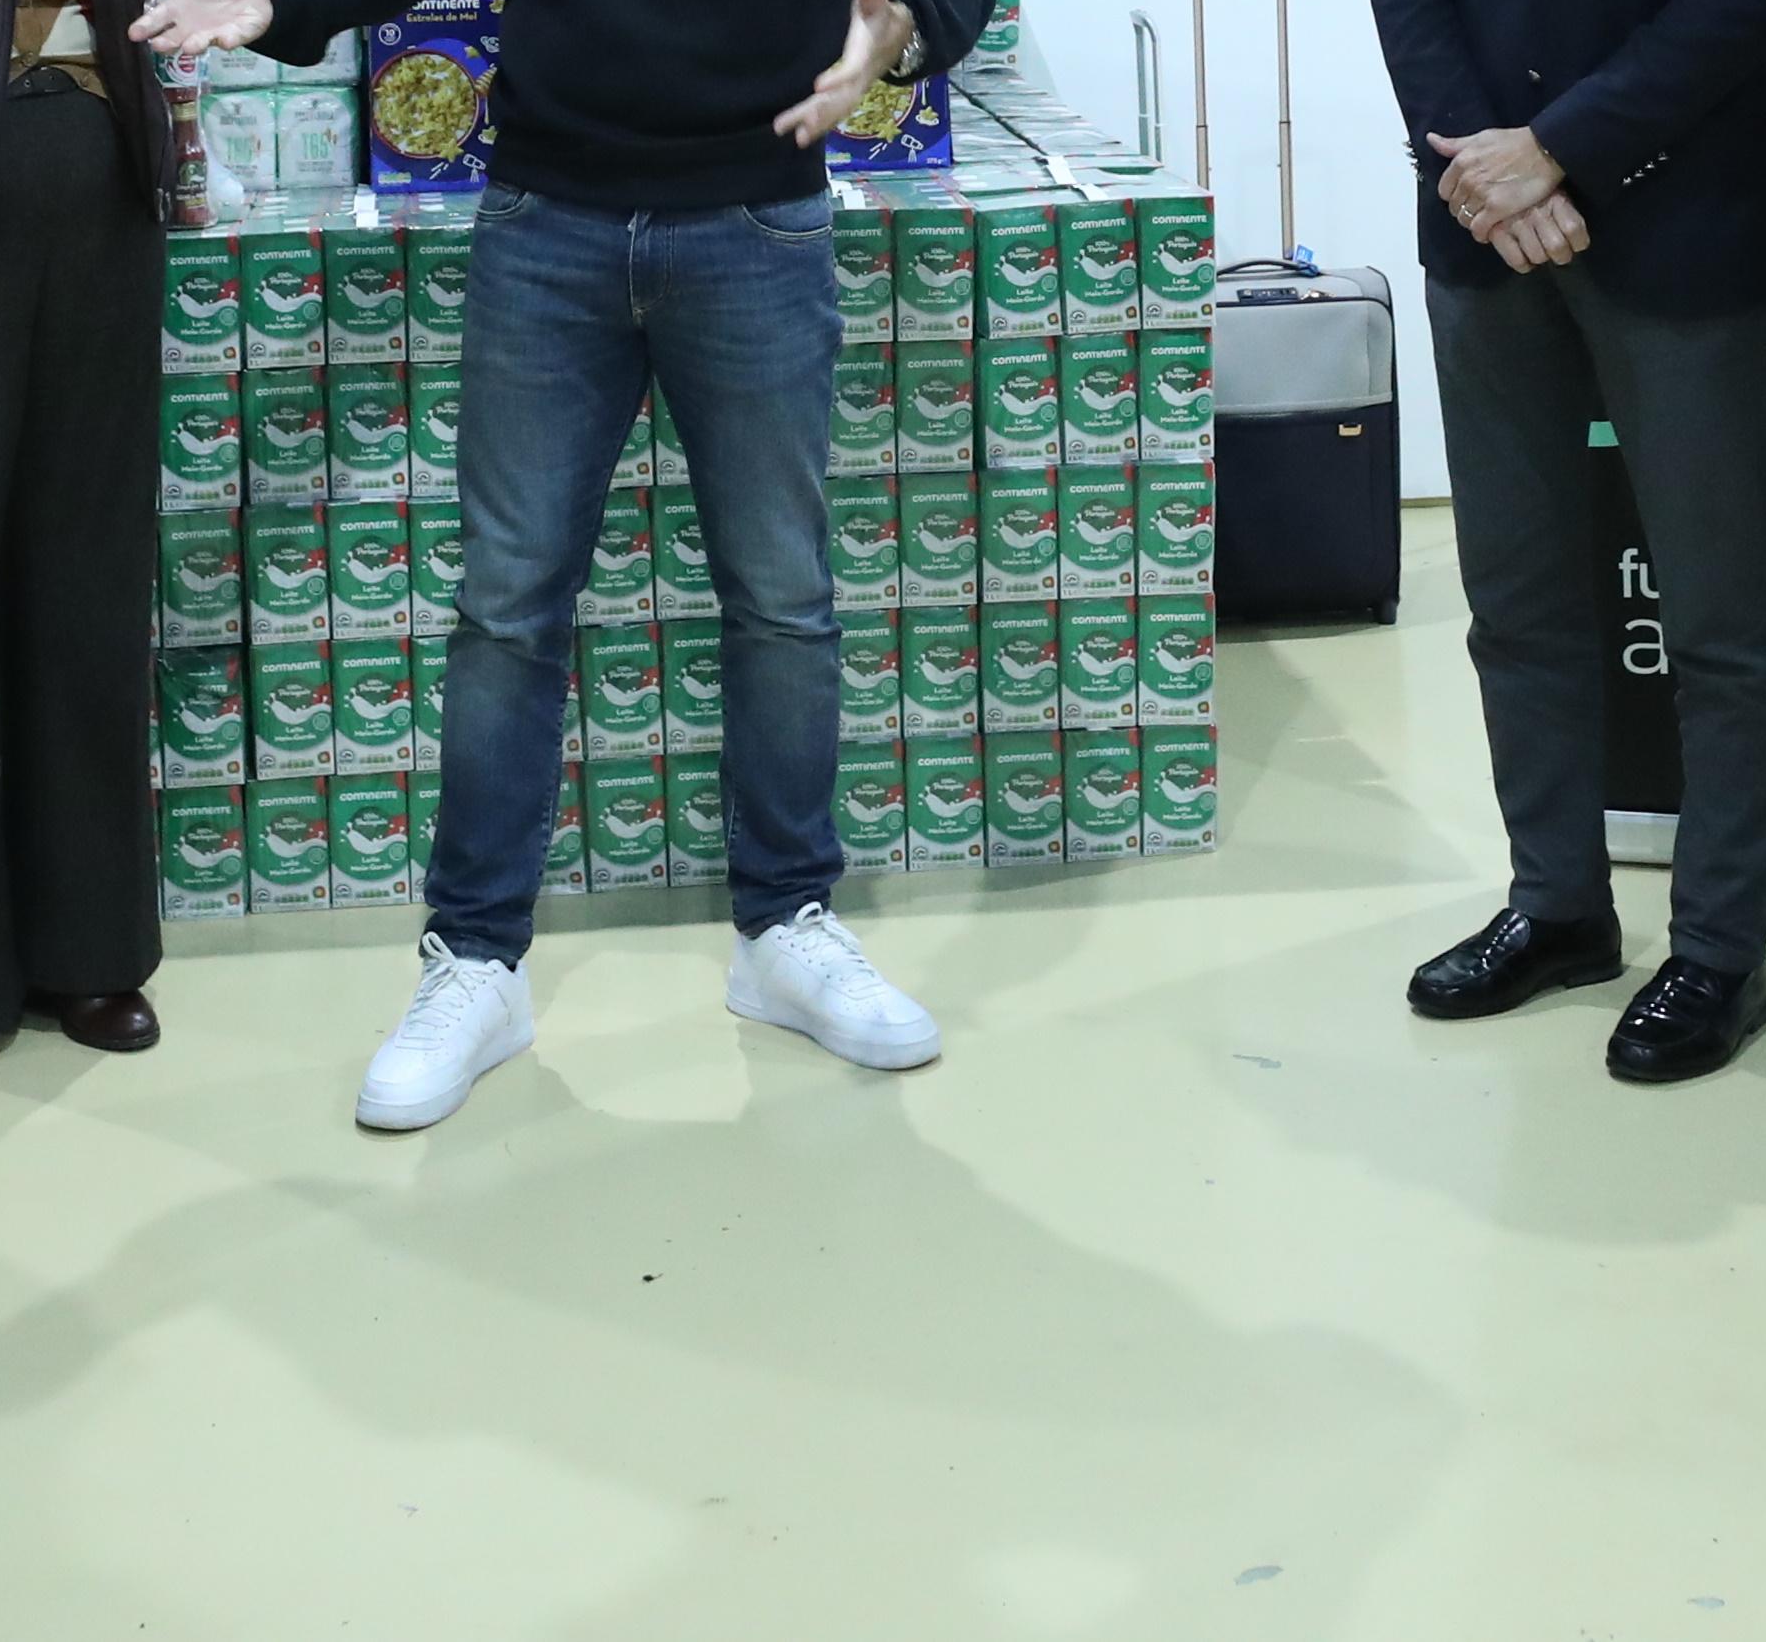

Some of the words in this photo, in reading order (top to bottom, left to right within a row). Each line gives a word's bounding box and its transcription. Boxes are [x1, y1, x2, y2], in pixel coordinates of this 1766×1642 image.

[406, 11, 444, 22] Estrelas
[446, 11, 458, 22] de
[459, 11, 477, 22] Mel
[1071, 217, 1126, 229] CONTINENTE
[1152, 215, 1207, 224] CONTINENTE
[908, 226, 965, 235] CONTINENTE
[991, 224, 1047, 236] CONTINENTE
[253, 249, 312, 261] CONTINENTE
[336, 245, 395, 256] CONTINENTE
[170, 254, 229, 266] CONTINENTE
[1072, 349, 1128, 360] CONTINENTE
[1151, 345, 1206, 355] CONTINENTE
[907, 359, 964, 369] CONTINENTE
[992, 354, 1048, 365] CONTINENTE
[255, 384, 314, 397] CONTINENTE
[339, 381, 397, 392] CONTINENTE
[170, 392, 229, 403] CONTINENTE
[1069, 483, 1125, 494] CONTINENTE
[1150, 481, 1206, 491] CONTINENTE
[912, 493, 969, 503] CONTINENTE
[992, 487, 1048, 498] CONTINENTE
[832, 496, 889, 506] CONTINENTE
[256, 525, 316, 537] CONTINENTE
[340, 520, 399, 531] CONTINENTE
[171, 529, 231, 540] CONTINENTE
[992, 618, 1049, 629] CONTINENTE
[1071, 614, 1128, 625] CONTINENTE
[1150, 613, 1206, 623] CONTINENTE
[913, 624, 970, 635] CONTINENTE
[593, 643, 650, 655] CONTINENTE
[262, 660, 321, 673] CONTINENTE
[343, 657, 401, 668] CONTINENTE
[1076, 747, 1130, 758] CONTINENTE
[1154, 742, 1210, 753] CONTINENTE
[917, 756, 974, 767] CONTINENTE
[996, 752, 1054, 764] CONTINENTE
[838, 761, 895, 772] CONTINENTE
[597, 775, 655, 788] CONTINENTE
[258, 795, 317, 807] CONTINENTE
[339, 790, 398, 802] CONTINENTE
[172, 806, 232, 817] CONTINENTE
